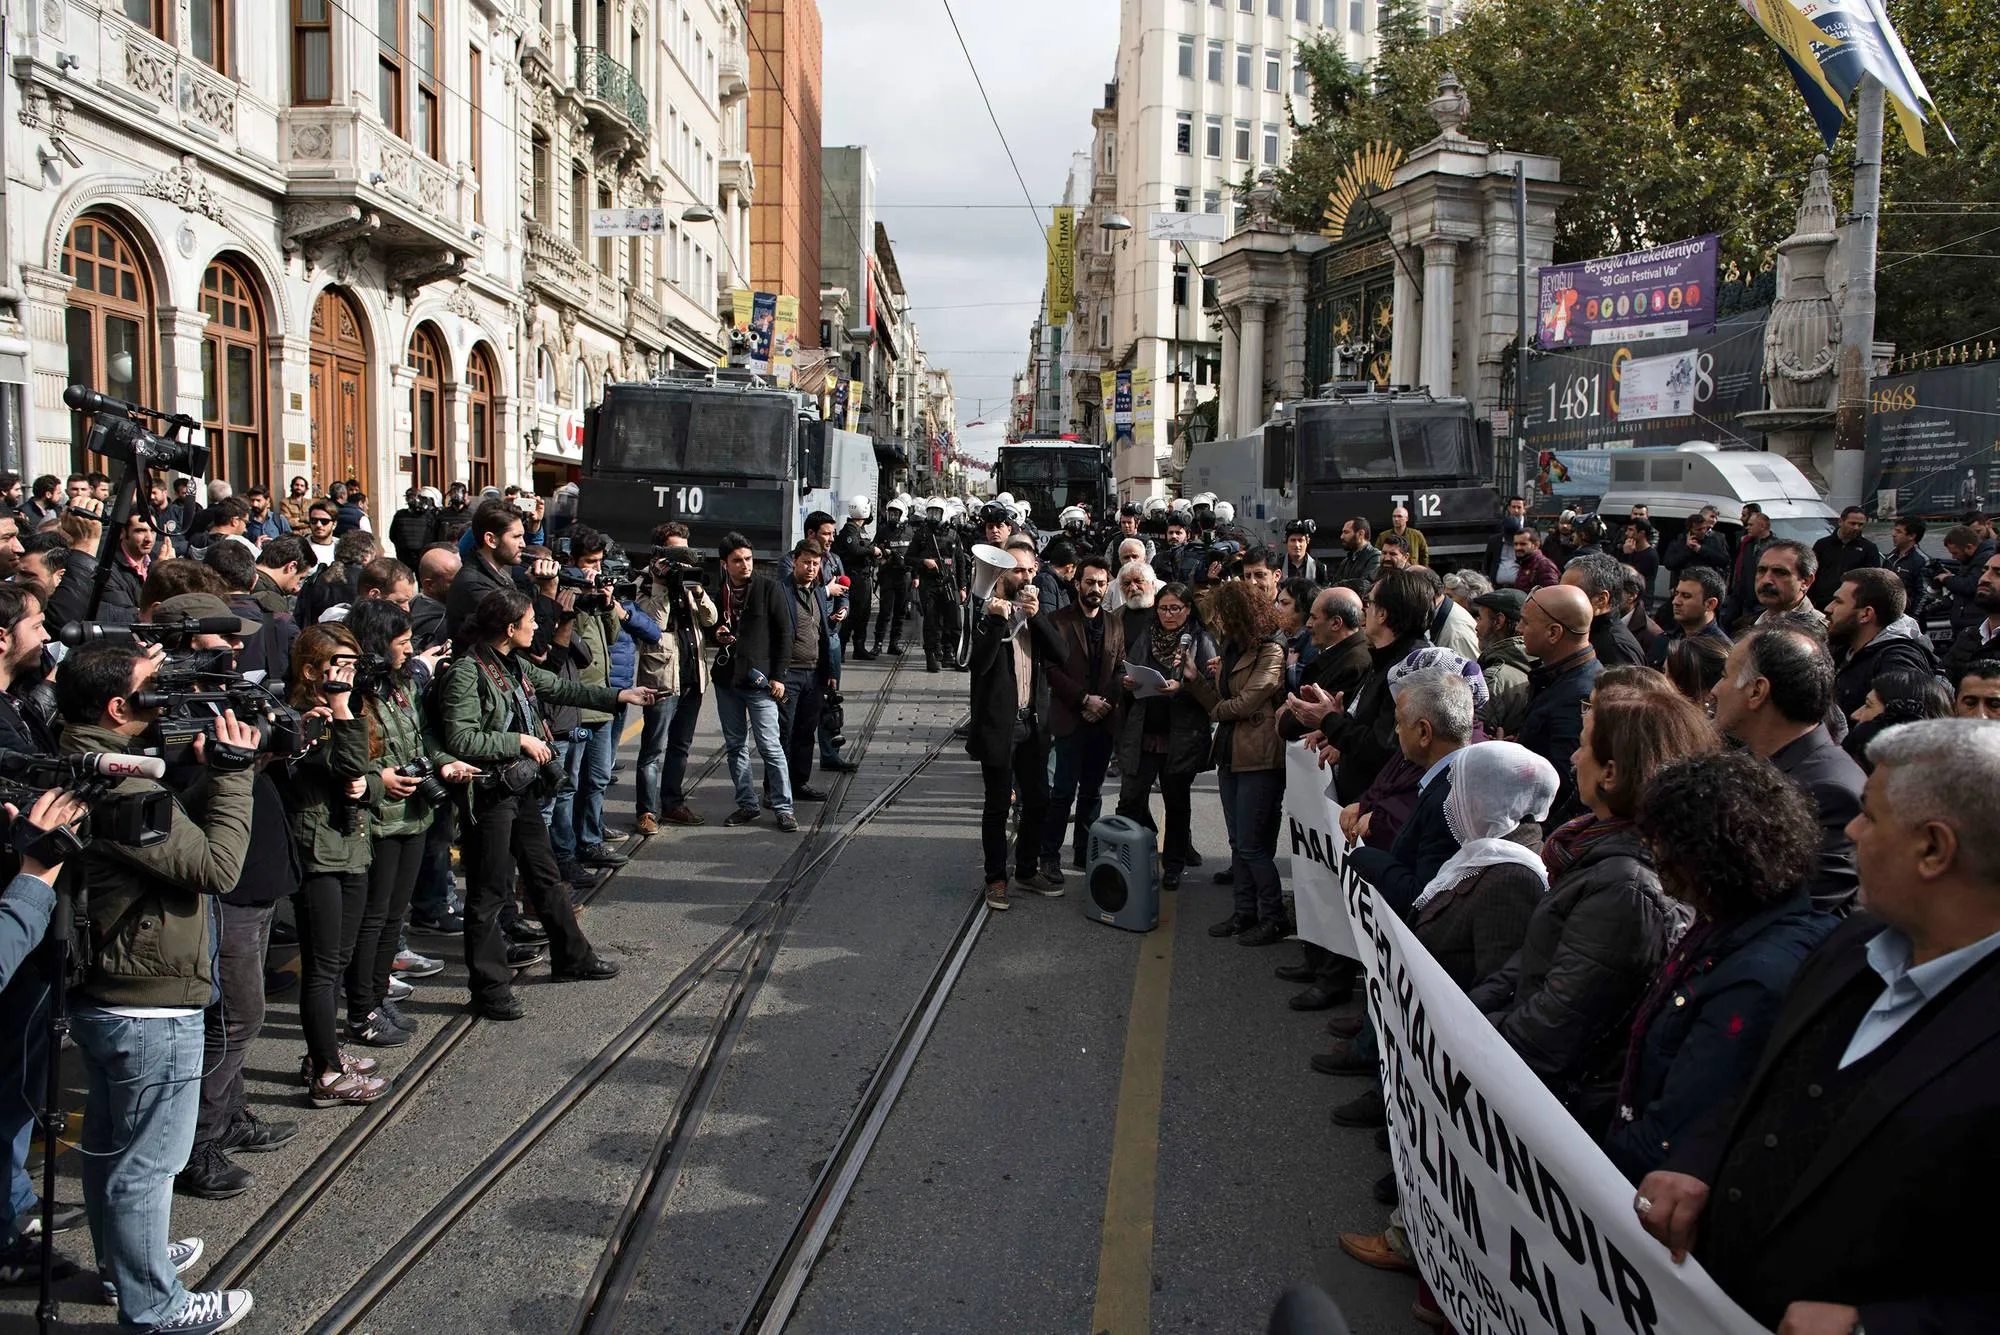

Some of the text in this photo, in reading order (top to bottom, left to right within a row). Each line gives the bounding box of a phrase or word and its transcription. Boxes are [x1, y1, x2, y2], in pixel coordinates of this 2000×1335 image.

[1060, 212, 1069, 241] TIME
[1541, 271, 1574, 294] BEYOĞLU
[1614, 271, 1630, 285] Gün
[1631, 267, 1662, 283] Festival
[1694, 352, 1714, 403] 8
[1547, 372, 1601, 423] 1481
[1871, 382, 1917, 415] 1868
[676, 487, 703, 514] 10
[1418, 493, 1442, 517] 12
[109, 762, 144, 776] DHA
[222, 752, 245, 761] SONY
